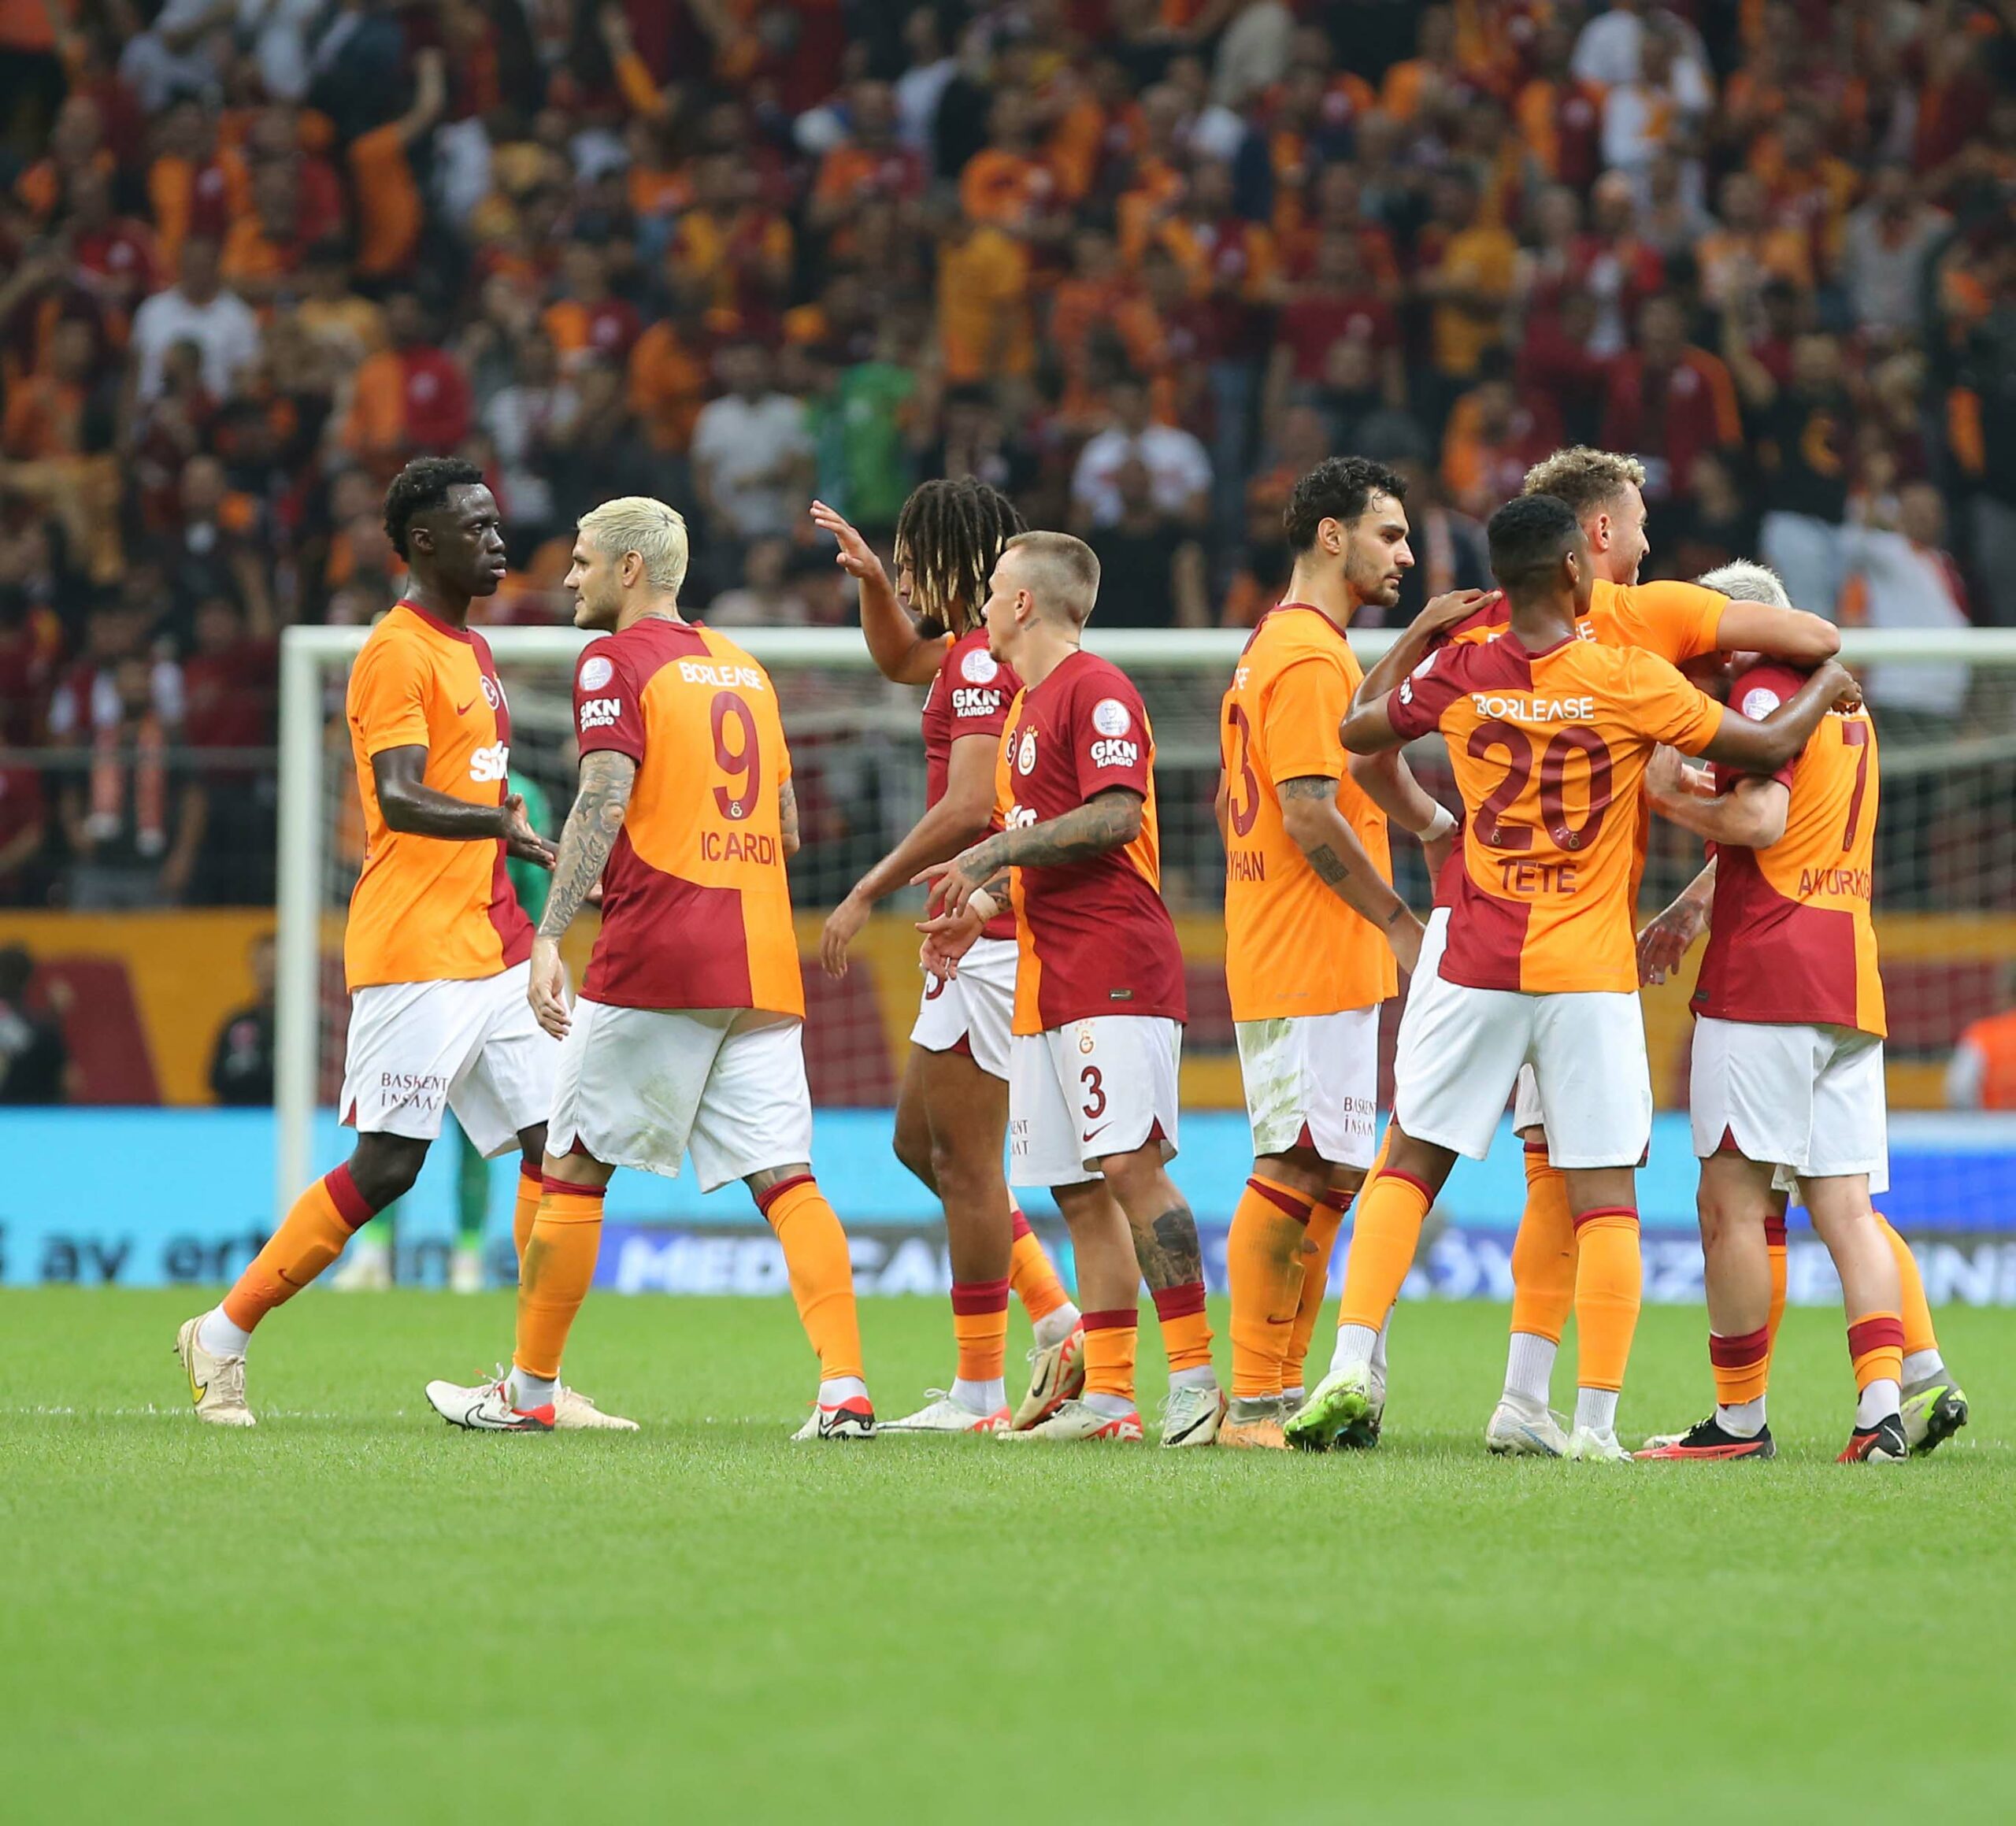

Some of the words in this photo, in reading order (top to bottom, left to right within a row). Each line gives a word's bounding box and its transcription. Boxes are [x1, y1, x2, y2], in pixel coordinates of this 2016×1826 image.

[679, 662, 764, 691] BORLEASE
[952, 688, 1001, 708] GKN
[957, 706, 995, 717] KARGO
[1472, 695, 1594, 722] BORLEASE
[710, 691, 760, 820] 9
[1091, 739, 1137, 761] GKN
[1097, 756, 1133, 769] KARGO
[1221, 703, 1259, 837] 3
[1467, 720, 1613, 852] 20
[1842, 720, 1870, 852] 7
[701, 832, 776, 866] ICARDI
[1227, 851, 1265, 881] YHAN
[1080, 1065, 1106, 1119] 3
[1344, 1097, 1377, 1117] BAŞKEN
[1345, 1114, 1377, 1137] İNŞAA
